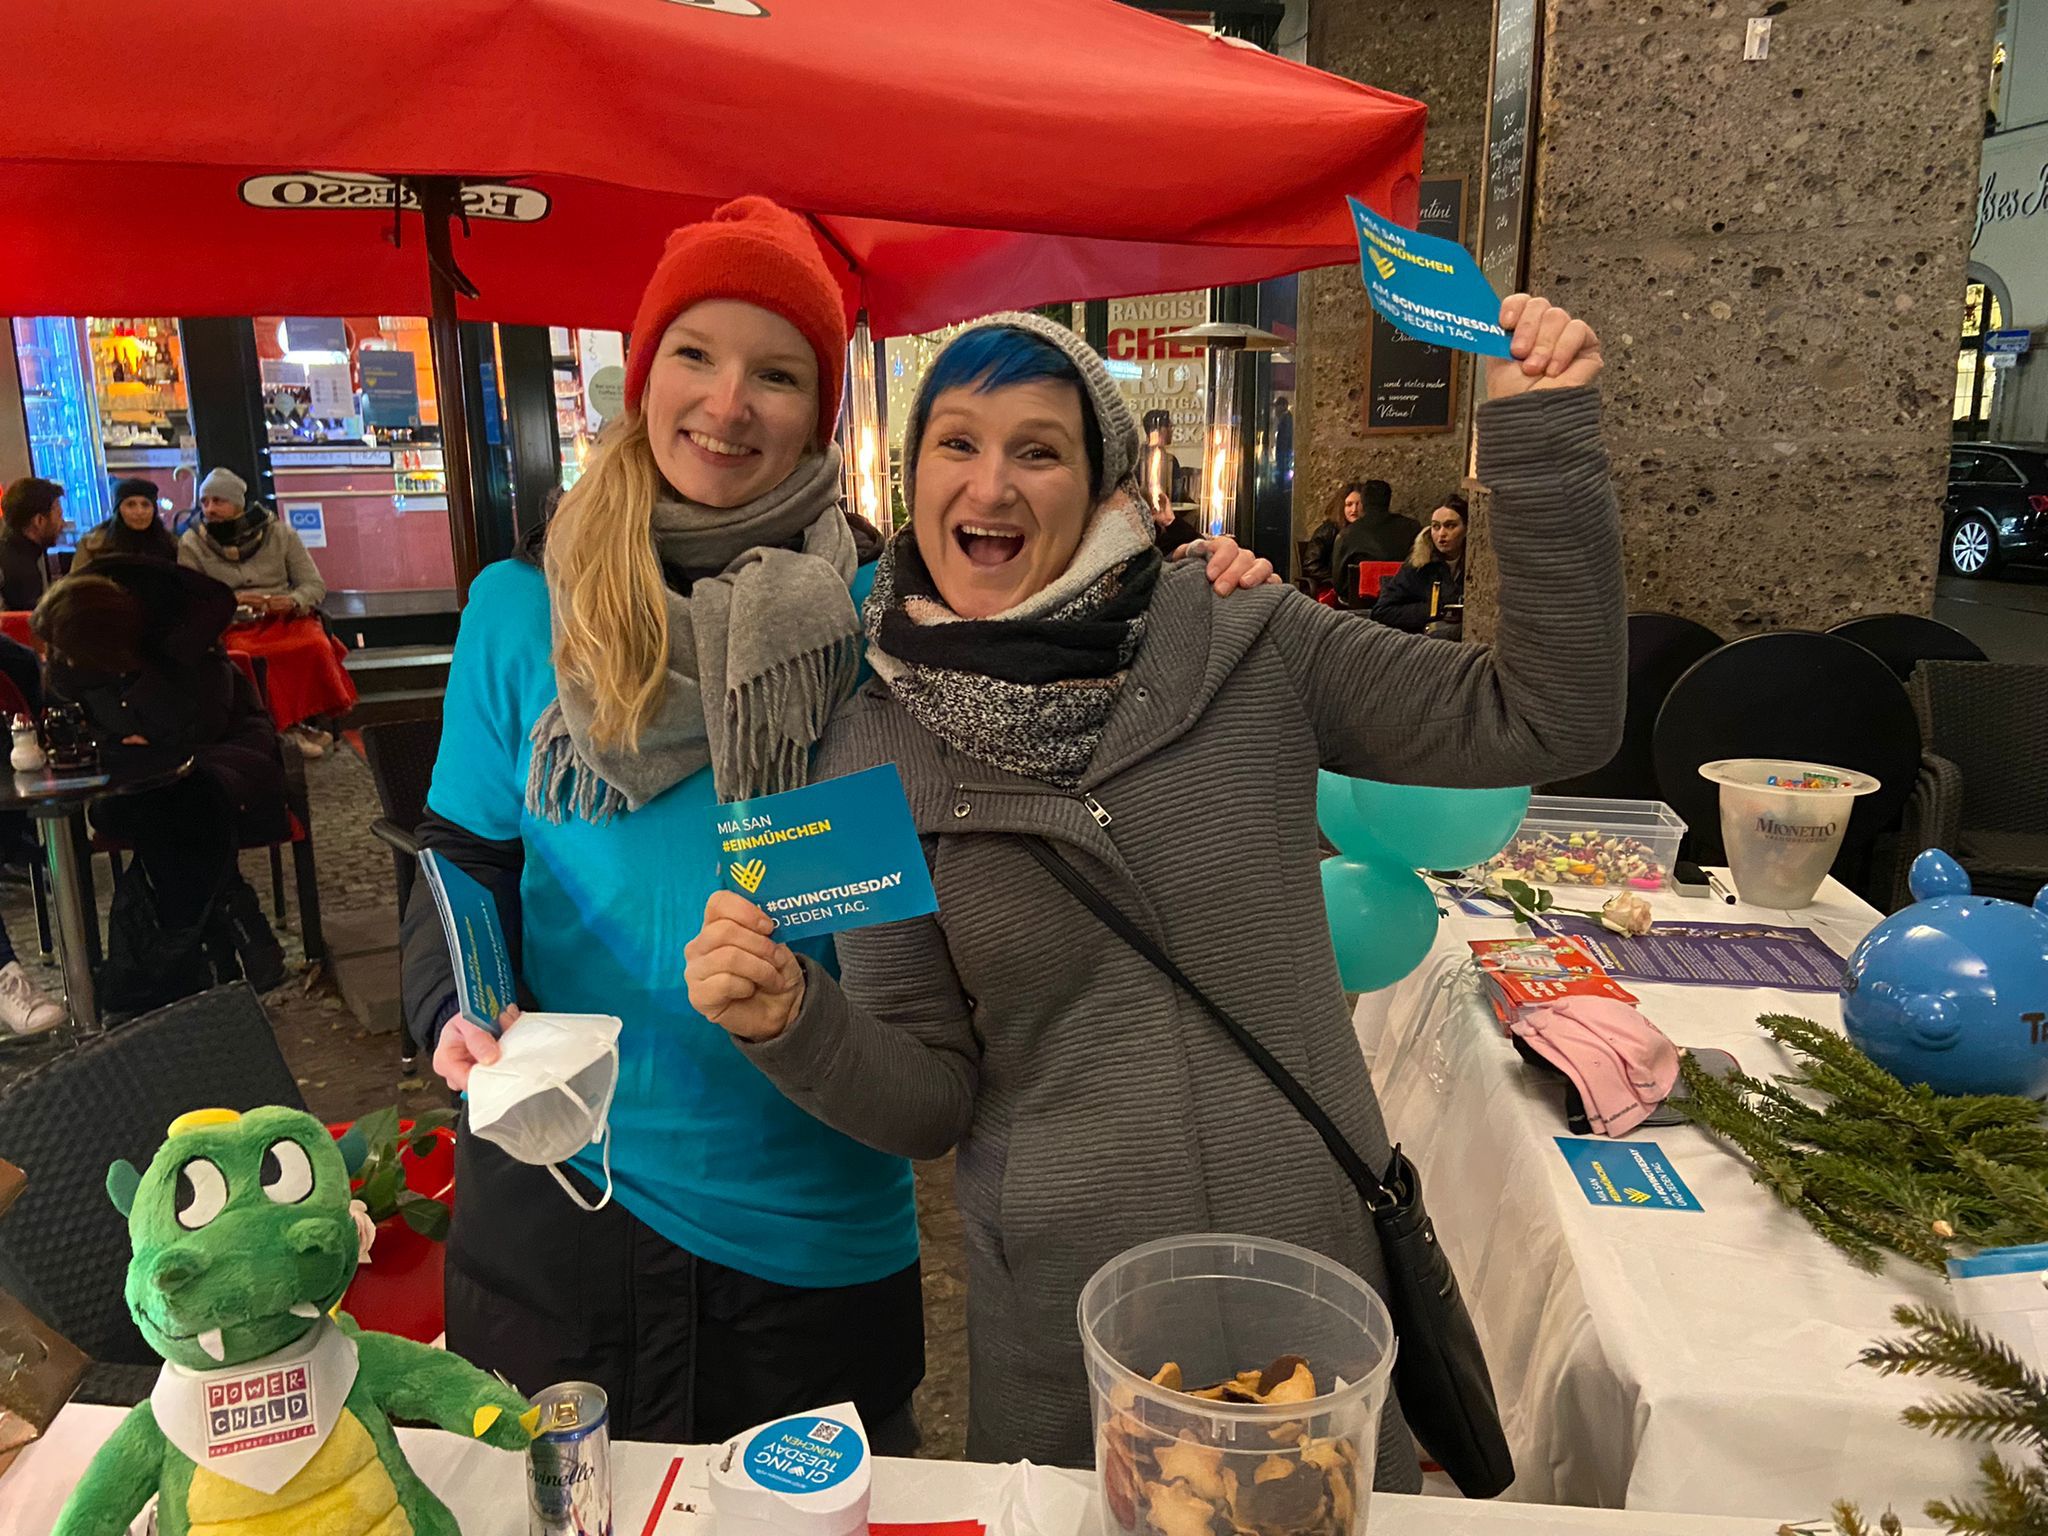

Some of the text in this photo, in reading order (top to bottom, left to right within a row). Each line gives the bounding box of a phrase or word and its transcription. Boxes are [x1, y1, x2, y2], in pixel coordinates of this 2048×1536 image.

[1363, 227, 1454, 275] #EINMÜNCHEN
[1382, 228, 1406, 247] SAN
[1374, 294, 1479, 342] UND JEDEN TAG.
[1391, 293, 1506, 337] #GIVINGTUESDAY
[1376, 403, 1416, 419] Vitrine!
[717, 814, 773, 835] MIA SAN
[722, 819, 832, 853] #EINMÜNCHEN
[766, 871, 903, 913] #GIVINGTUESDAY
[783, 906, 834, 927] JEDEN
[834, 900, 870, 916] TAG.
[214, 1398, 303, 1432] CHILD
[763, 1442, 838, 1473] TUESDAY
[781, 1434, 844, 1460] MÜNCHEN
